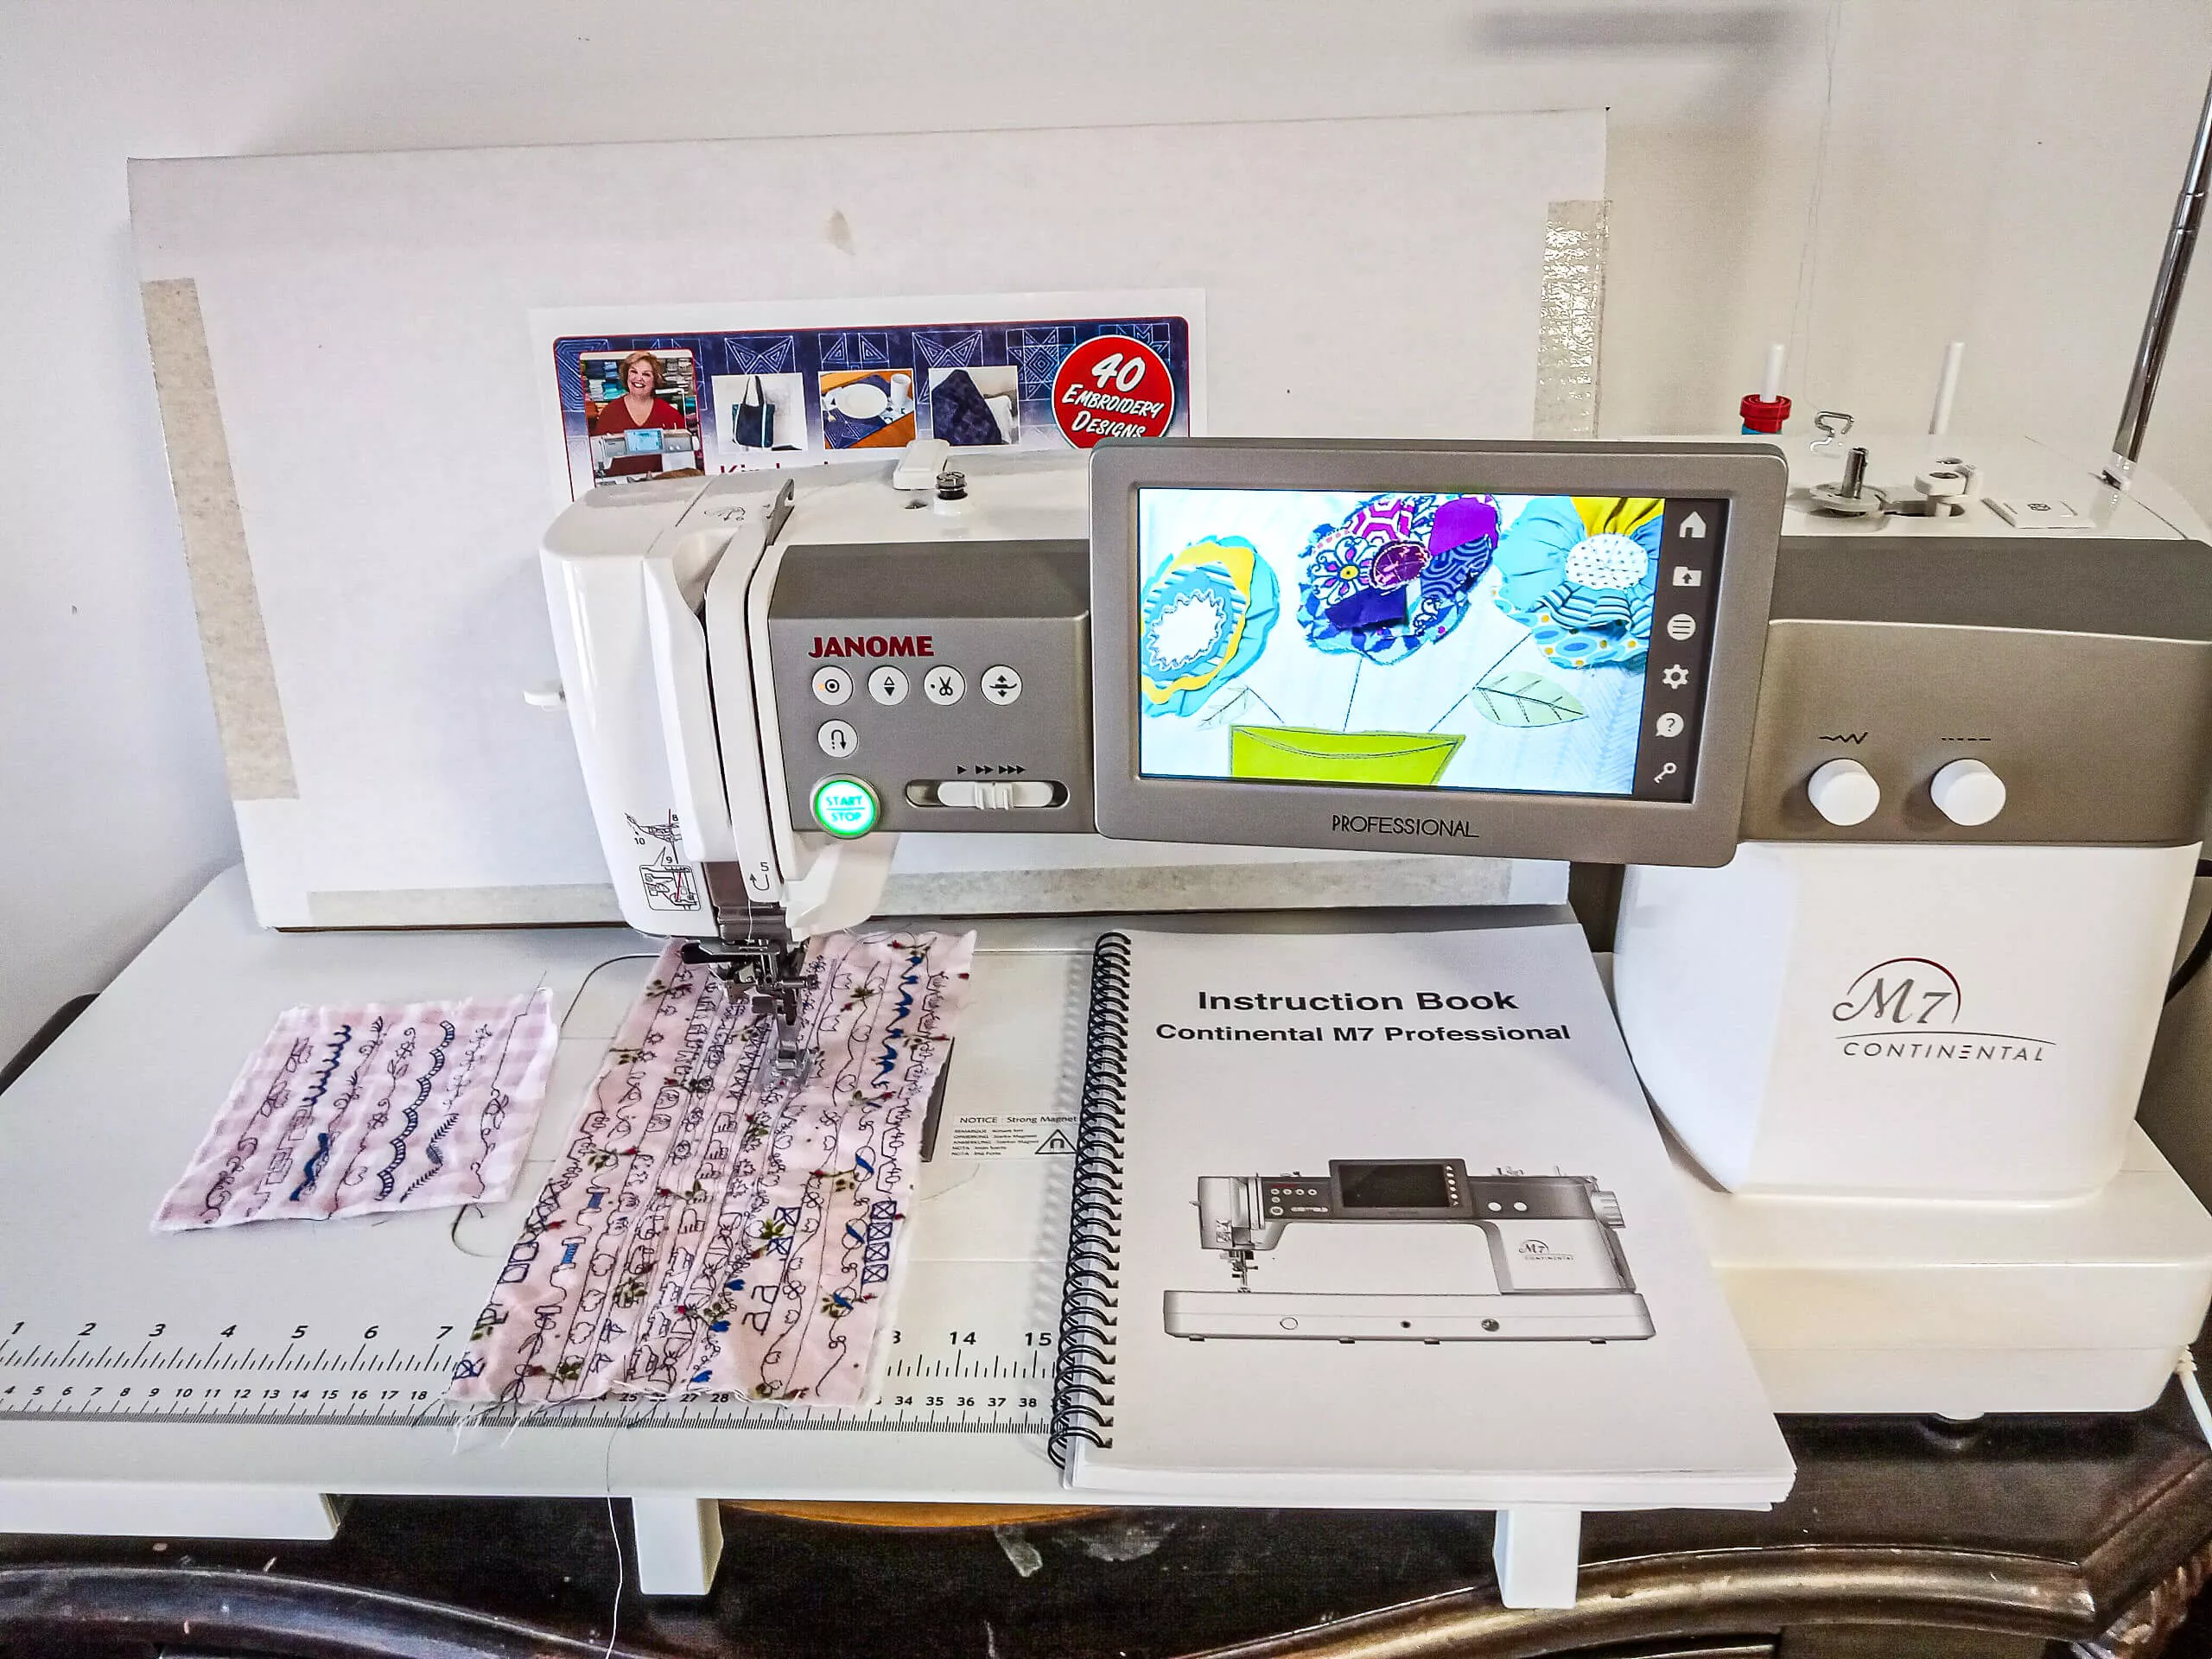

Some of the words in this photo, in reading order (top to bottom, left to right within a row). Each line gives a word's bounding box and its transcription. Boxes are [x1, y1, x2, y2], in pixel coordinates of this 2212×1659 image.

[1091, 353, 1147, 393] 40
[1061, 383, 1165, 419] EMBROIDERY
[808, 635, 935, 658] JANOME
[825, 795, 864, 807] START
[831, 810, 862, 822] STOP
[1332, 814, 1480, 838] PROFESSIONAL
[665, 855, 673, 864] 9
[760, 861, 769, 872] 5
[1198, 991, 1404, 1011] Instruction
[1415, 990, 1520, 1010] Book
[1832, 976, 1953, 1025] M7
[1155, 1023, 1323, 1042] Continental
[1332, 1027, 1375, 1041] M7
[1384, 1024, 1571, 1042] Professional
[1843, 1041, 2045, 1062] CONTINENTAL
[1039, 1116, 1078, 1124] Magnet
[11, 1321, 25, 1335] 1
[77, 1322, 97, 1336] 2
[149, 1323, 167, 1338] 3
[219, 1324, 238, 1338] 4
[290, 1325, 308, 1339] 5
[364, 1325, 379, 1339] 6
[435, 1325, 454, 1339] 7
[893, 1330, 901, 1344] 3
[950, 1331, 976, 1345] 14
[1025, 1332, 1052, 1346] 15
[3, 1385, 16, 1395] 4
[32, 1386, 45, 1395] 5
[61, 1386, 73, 1396] 6
[90, 1387, 104, 1396] 7
[119, 1387, 131, 1397] 8
[149, 1388, 160, 1397] 9
[175, 1388, 193, 1398] 10
[204, 1389, 221, 1398] 11
[233, 1389, 251, 1399] 12
[263, 1389, 281, 1399] 13
[292, 1389, 309, 1399] 14
[321, 1389, 340, 1400] 15
[351, 1389, 368, 1400] 16
[381, 1390, 399, 1400] 17
[410, 1390, 428, 1401] 18
[679, 1393, 699, 1402] 27
[710, 1393, 729, 1403] 28
[894, 1395, 913, 1406] 34
[925, 1395, 944, 1407] 35
[957, 1396, 975, 1407] 36
[987, 1397, 1007, 1408] 37
[1019, 1397, 1037, 1408] 38
